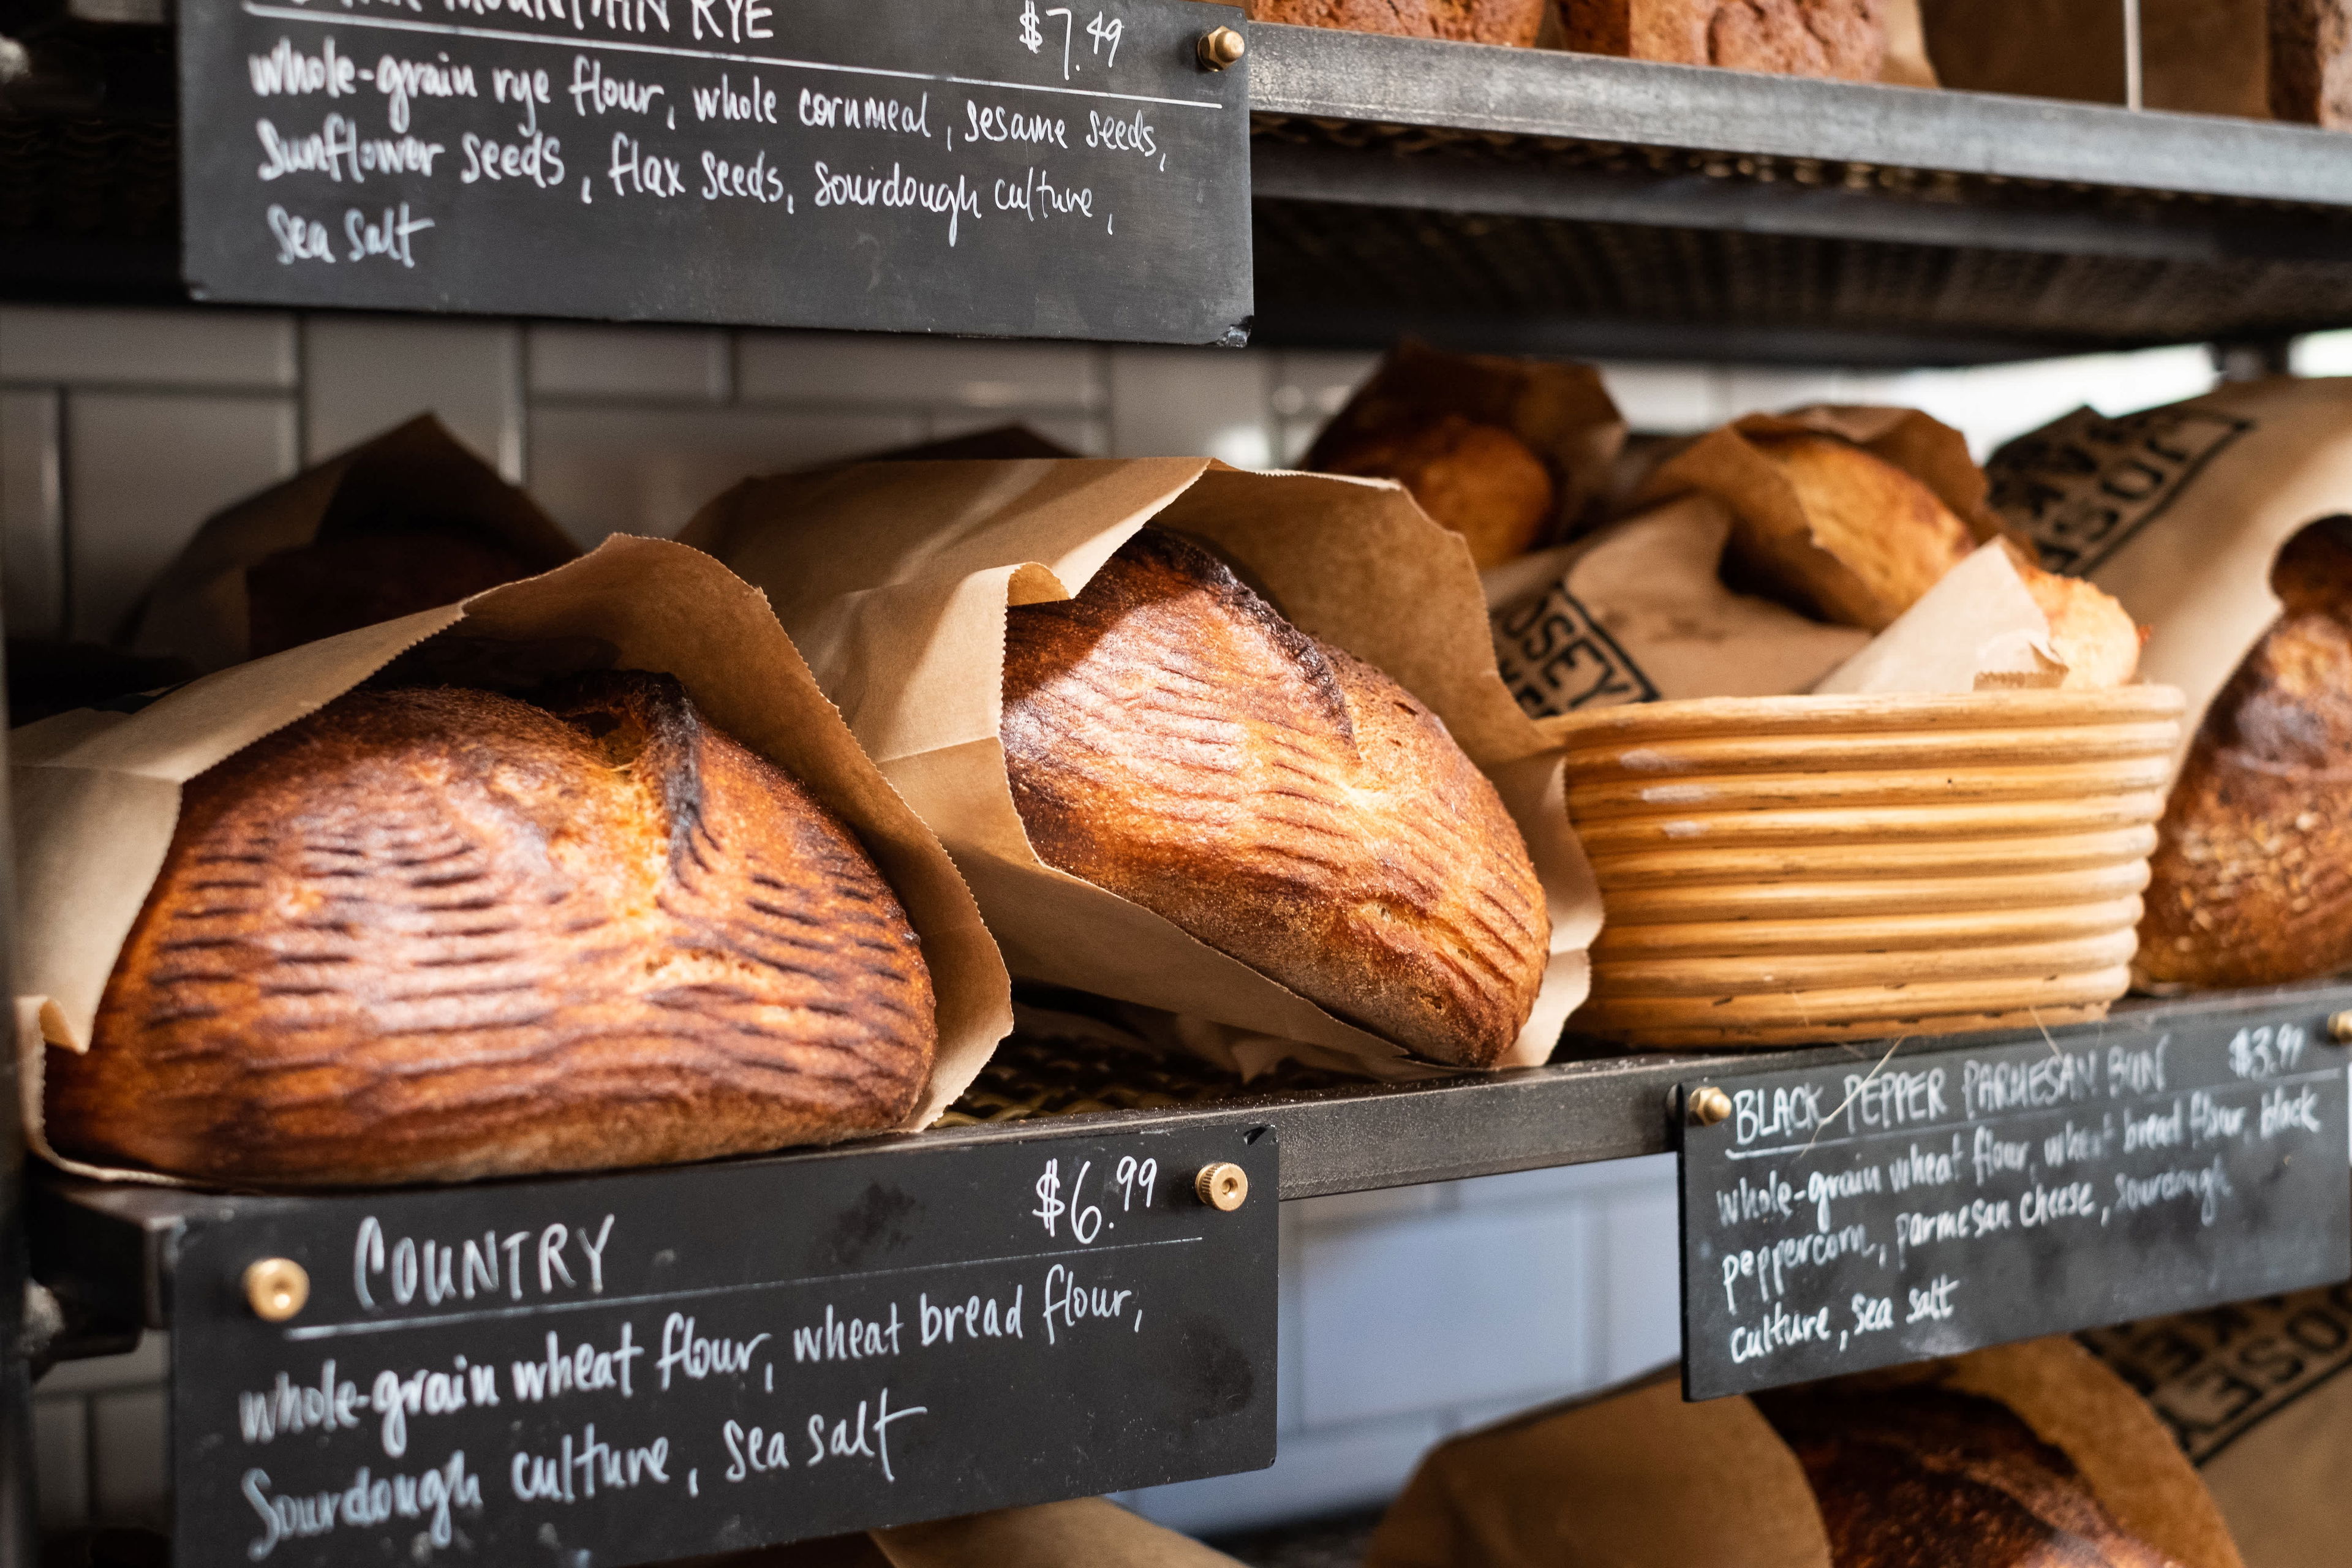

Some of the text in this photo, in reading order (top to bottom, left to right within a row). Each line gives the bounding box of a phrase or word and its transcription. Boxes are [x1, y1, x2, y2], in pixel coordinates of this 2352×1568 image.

[691, 0, 774, 43] RYE
[1019, 0, 1125, 81] $7.49
[249, 37, 478, 133] whole-grain
[492, 69, 551, 137] rye
[568, 55, 676, 130] flour,
[693, 74, 777, 124] whole
[964, 99, 1068, 149] sesame
[1085, 109, 1166, 172] seeds,
[608, 132, 686, 198] flax
[701, 151, 794, 214] seeds,
[1501, 592, 1632, 710] OSEY
[1733, 1082, 1826, 1145] BLACK
[1844, 1067, 1948, 1134] PEPPER
[1962, 1049, 2098, 1120] PARMESAN
[1031, 1155, 1158, 1245] $6.99
[1716, 1169, 1882, 1234] whole-grain
[1889, 1132, 1963, 1194] wheat
[1895, 1197, 2011, 1271] parmesan
[1851, 1292, 1895, 1336] sea
[1905, 1273, 1960, 1325] salt
[239, 1264, 1143, 1459] whole-grain wheat flour, wheat bread flour,
[807, 1387, 928, 1482] salt
